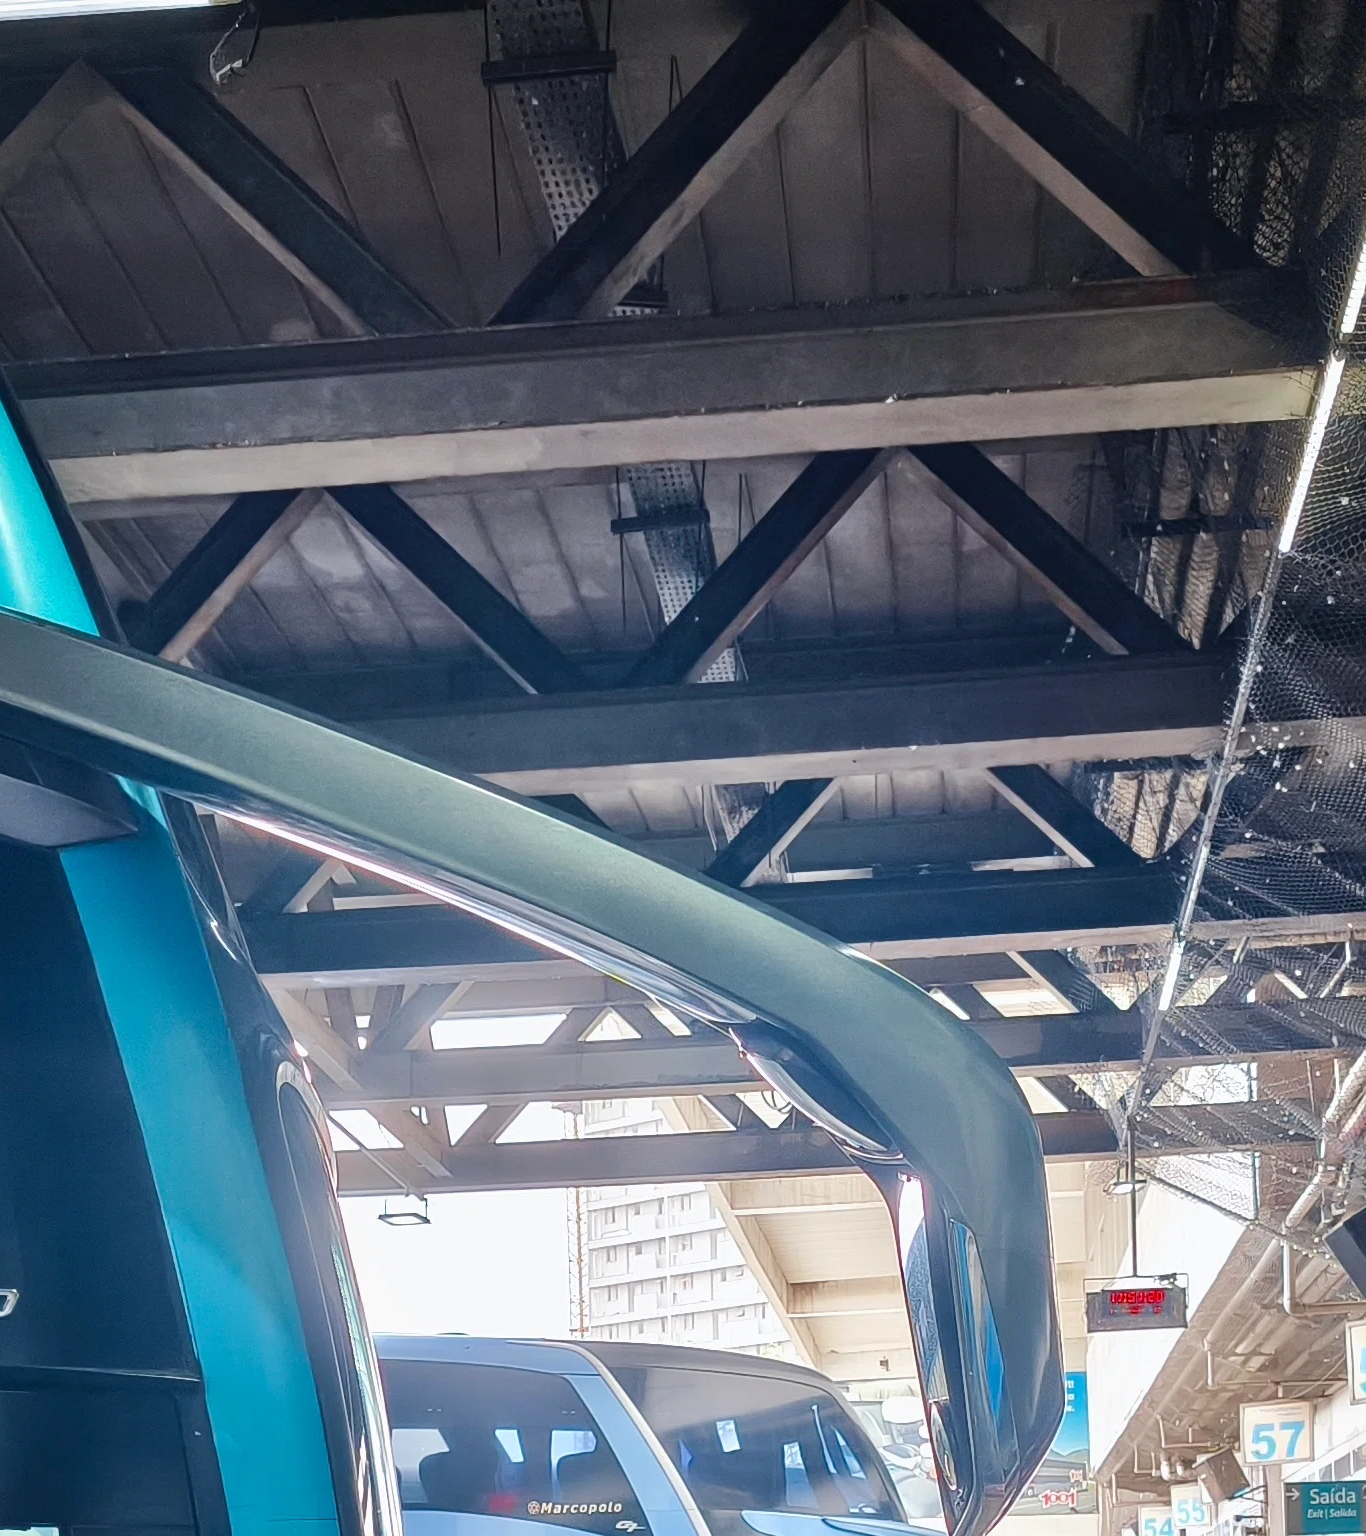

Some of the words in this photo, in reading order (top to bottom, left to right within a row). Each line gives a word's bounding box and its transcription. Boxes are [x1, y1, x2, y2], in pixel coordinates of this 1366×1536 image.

[1251, 1420, 1306, 1460] 57
[1041, 1490, 1077, 1509] 1001
[1309, 1486, 1357, 1505] Saída
[540, 1502, 623, 1515] Marcopolo
[1176, 1497, 1205, 1524] 55
[1307, 1508, 1324, 1519] Exit
[1329, 1507, 1357, 1518] Salida
